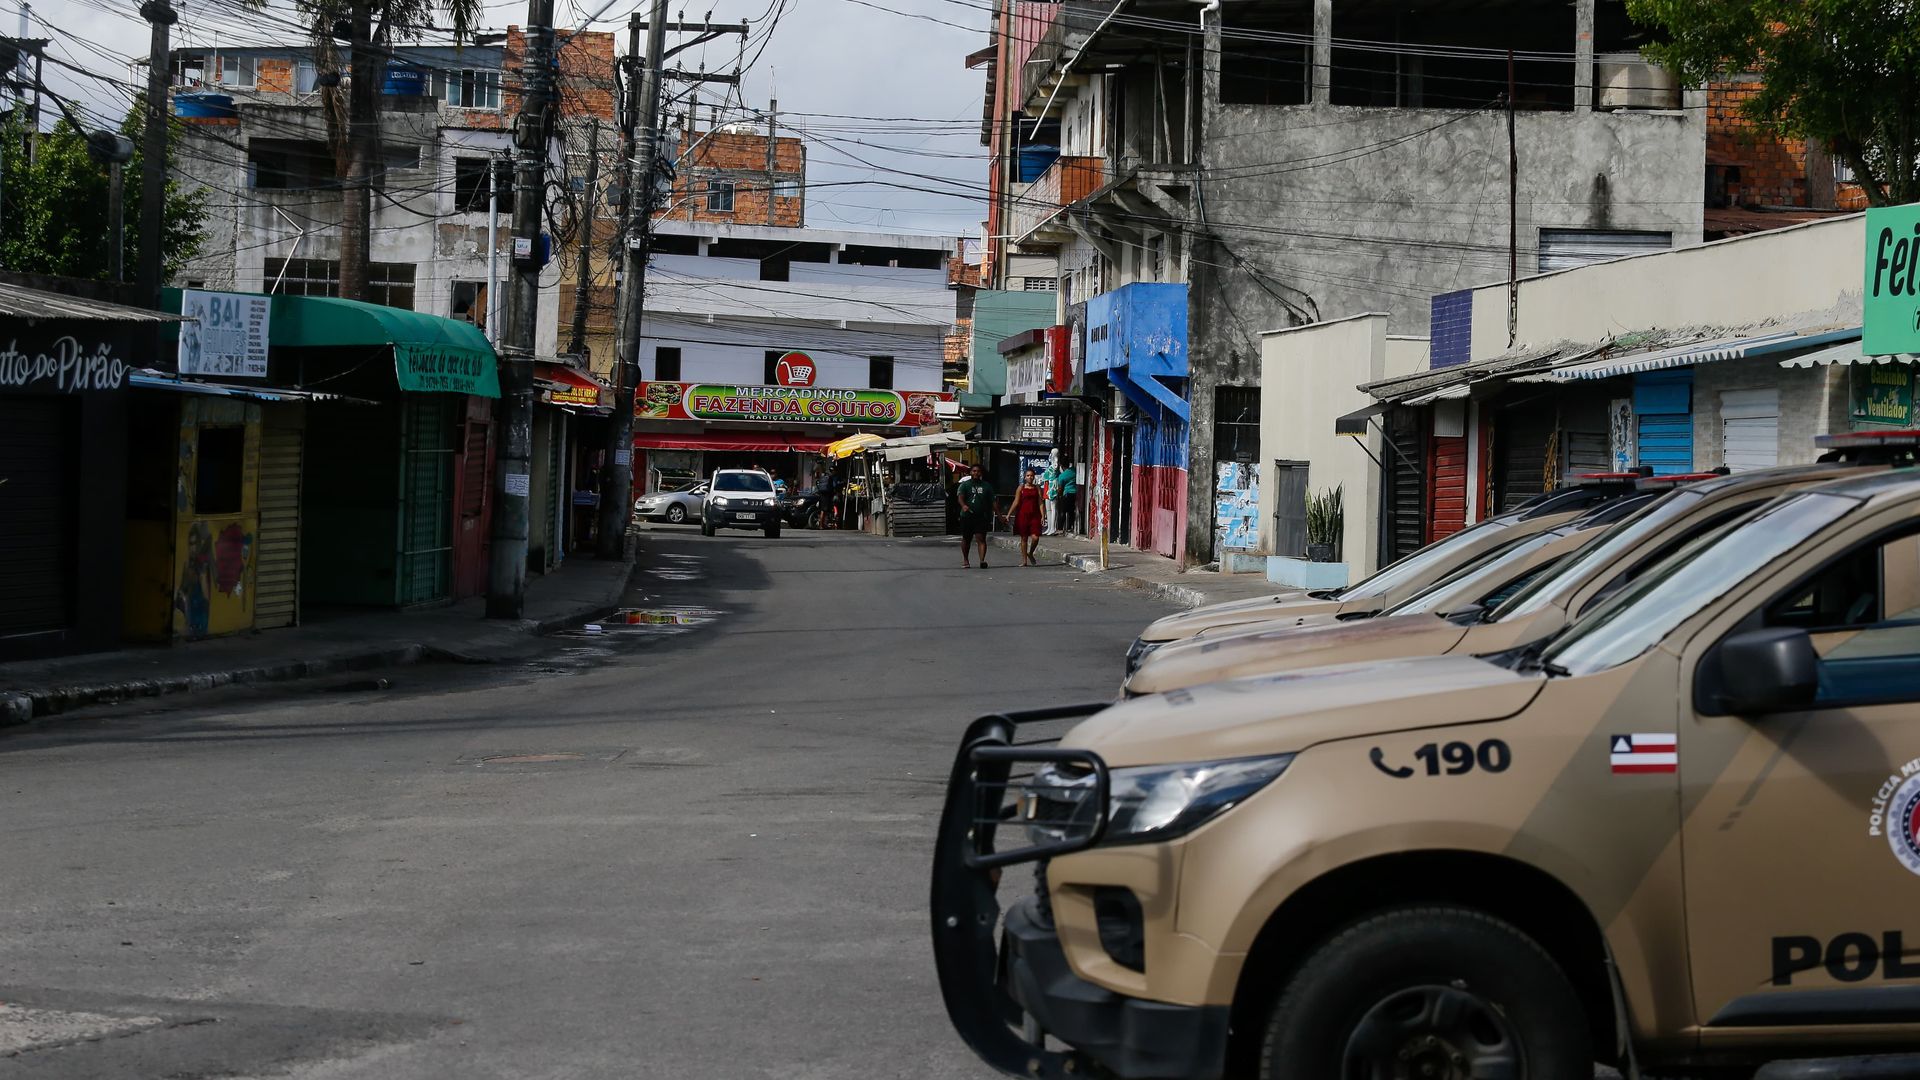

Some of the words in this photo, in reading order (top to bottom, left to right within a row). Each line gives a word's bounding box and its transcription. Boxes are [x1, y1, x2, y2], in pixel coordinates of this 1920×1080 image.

[1873, 222, 1920, 297] Fei
[52, 335, 124, 394] Pirão
[694, 396, 802, 415] FAZENDA
[808, 400, 896, 418] COUTOS
[736, 387, 856, 400] MERCADINHO
[1867, 396, 1908, 419] Ventilador
[1024, 418, 1042, 427] HGE
[1414, 738, 1512, 776] 190
[1869, 774, 1902, 836] POLÍCIA
[1900, 757, 1920, 777] MI
[1772, 930, 1920, 986] POL
